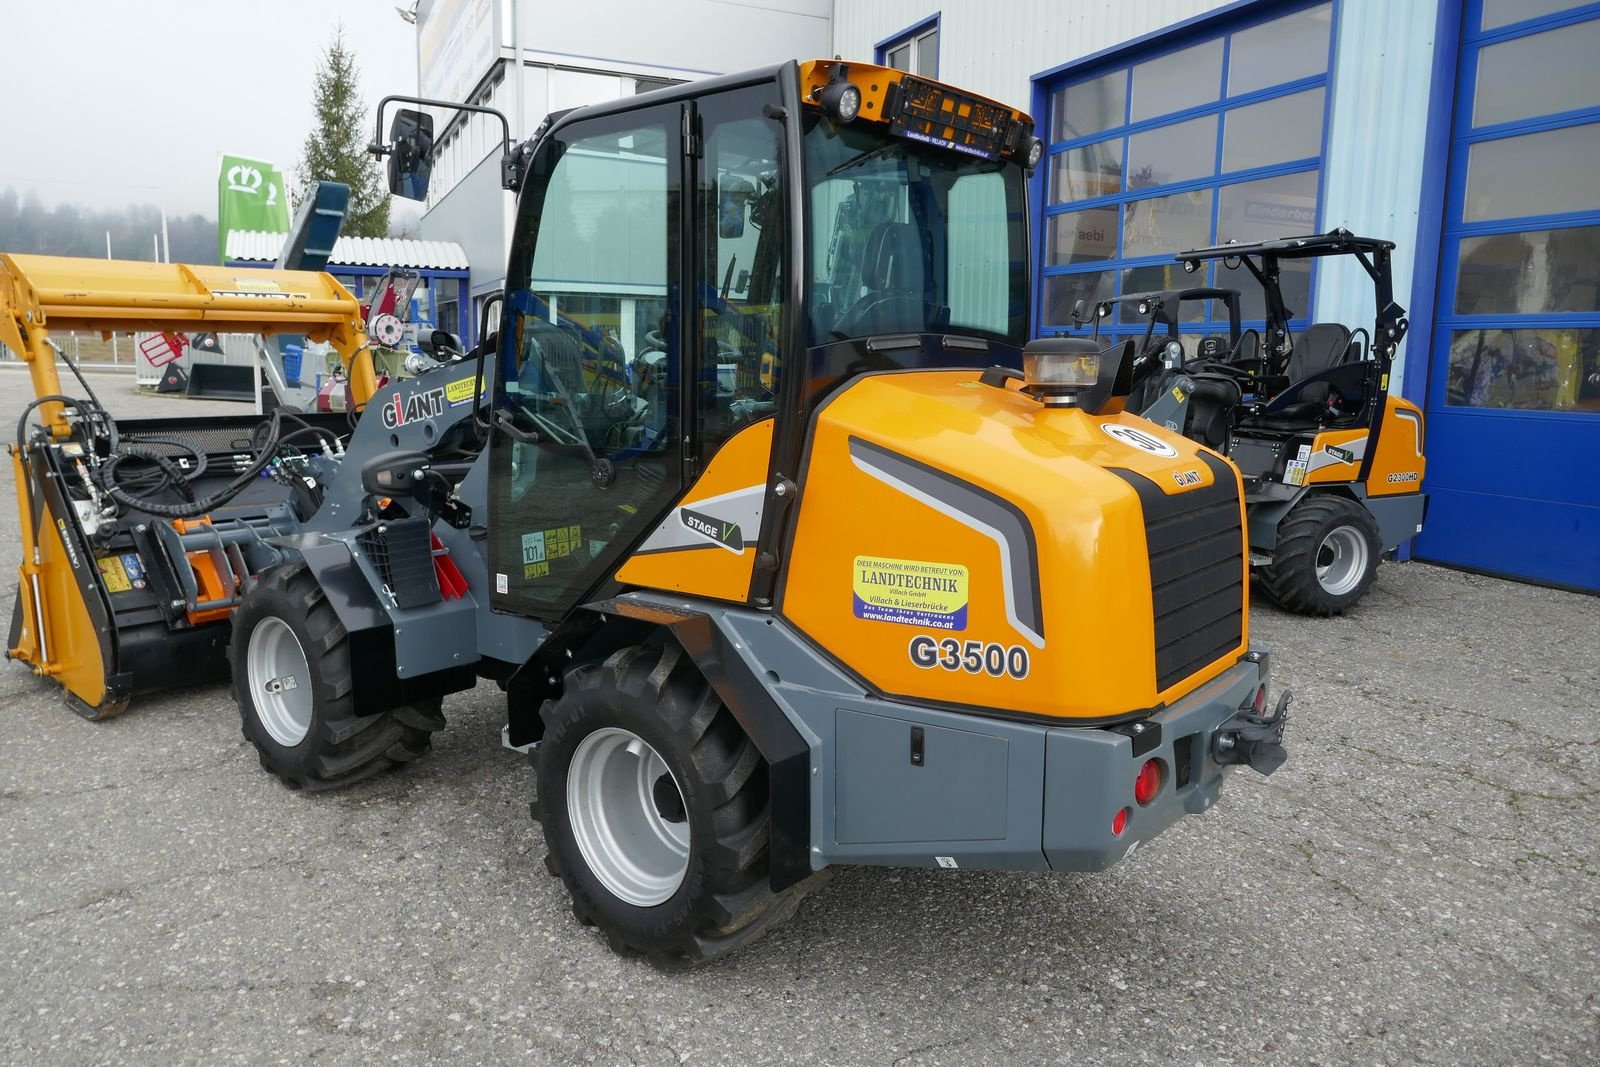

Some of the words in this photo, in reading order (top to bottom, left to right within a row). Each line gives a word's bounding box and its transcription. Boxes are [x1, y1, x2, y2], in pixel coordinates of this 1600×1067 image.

[1078, 229, 1105, 242] aebi
[1112, 429, 1168, 451] 30
[1328, 448, 1344, 459] STAGE
[1387, 472, 1418, 483] G2300HD
[687, 516, 718, 538] STAGE
[523, 545, 538, 561] 101
[857, 560, 873, 568] DIESE
[873, 561, 903, 571] MASCHINE
[920, 566, 948, 575] BETREUT
[862, 570, 959, 593] LANDTECHNIK
[890, 588, 908, 596] Villach
[909, 590, 927, 598] GmbH
[869, 595, 893, 605] Villach
[894, 598, 900, 606] &
[901, 599, 949, 612] Lieserbrücke
[863, 611, 954, 629] www.landtechnik.co.at
[909, 634, 1030, 680] G3500
